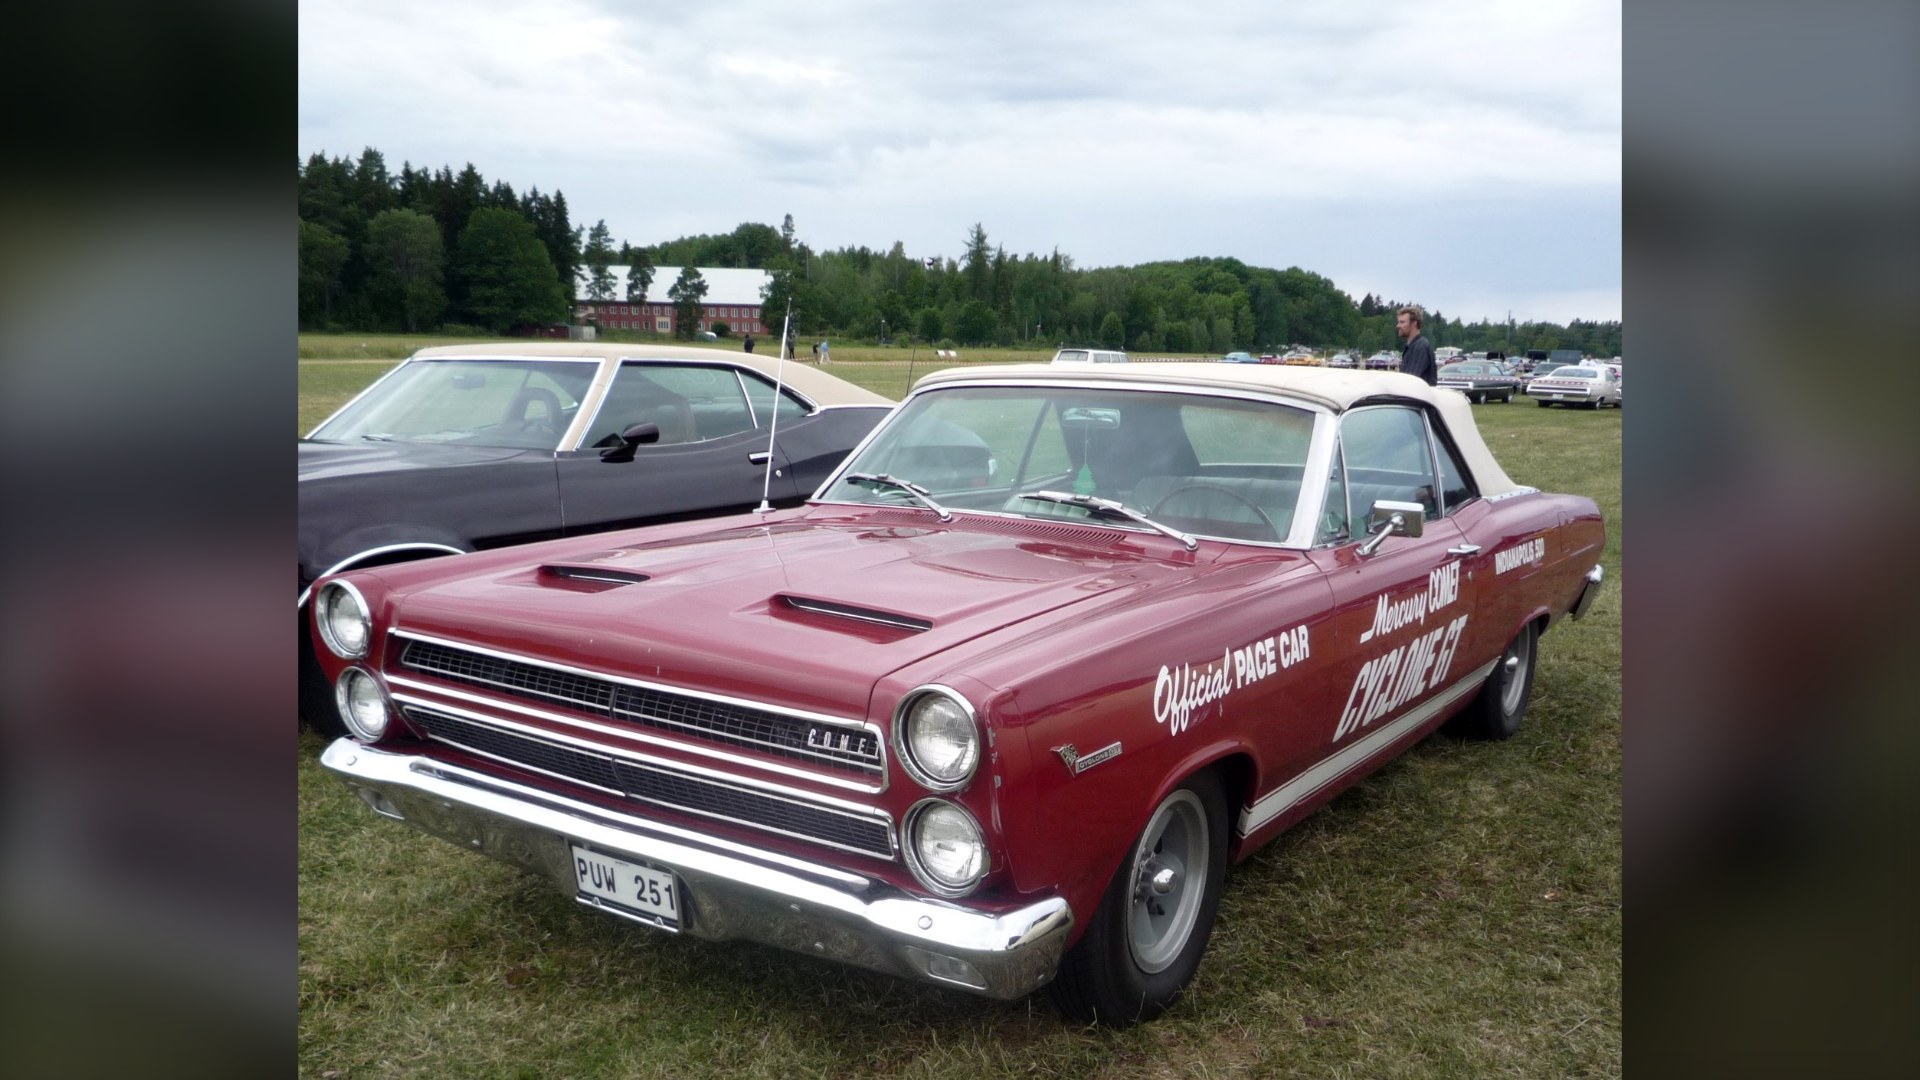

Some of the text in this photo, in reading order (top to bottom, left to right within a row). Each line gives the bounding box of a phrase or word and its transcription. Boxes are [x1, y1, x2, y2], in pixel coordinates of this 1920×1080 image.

[1495, 537, 1544, 576] INDIANAPOLIS 500
[1360, 560, 1460, 644] Mercury COMET
[1154, 624, 1310, 737] Official PACE CAR
[1332, 614, 1468, 743] CYCLONE GT
[1080, 751, 1108, 768] CYCLONE
[577, 857, 675, 911] PUW 251
